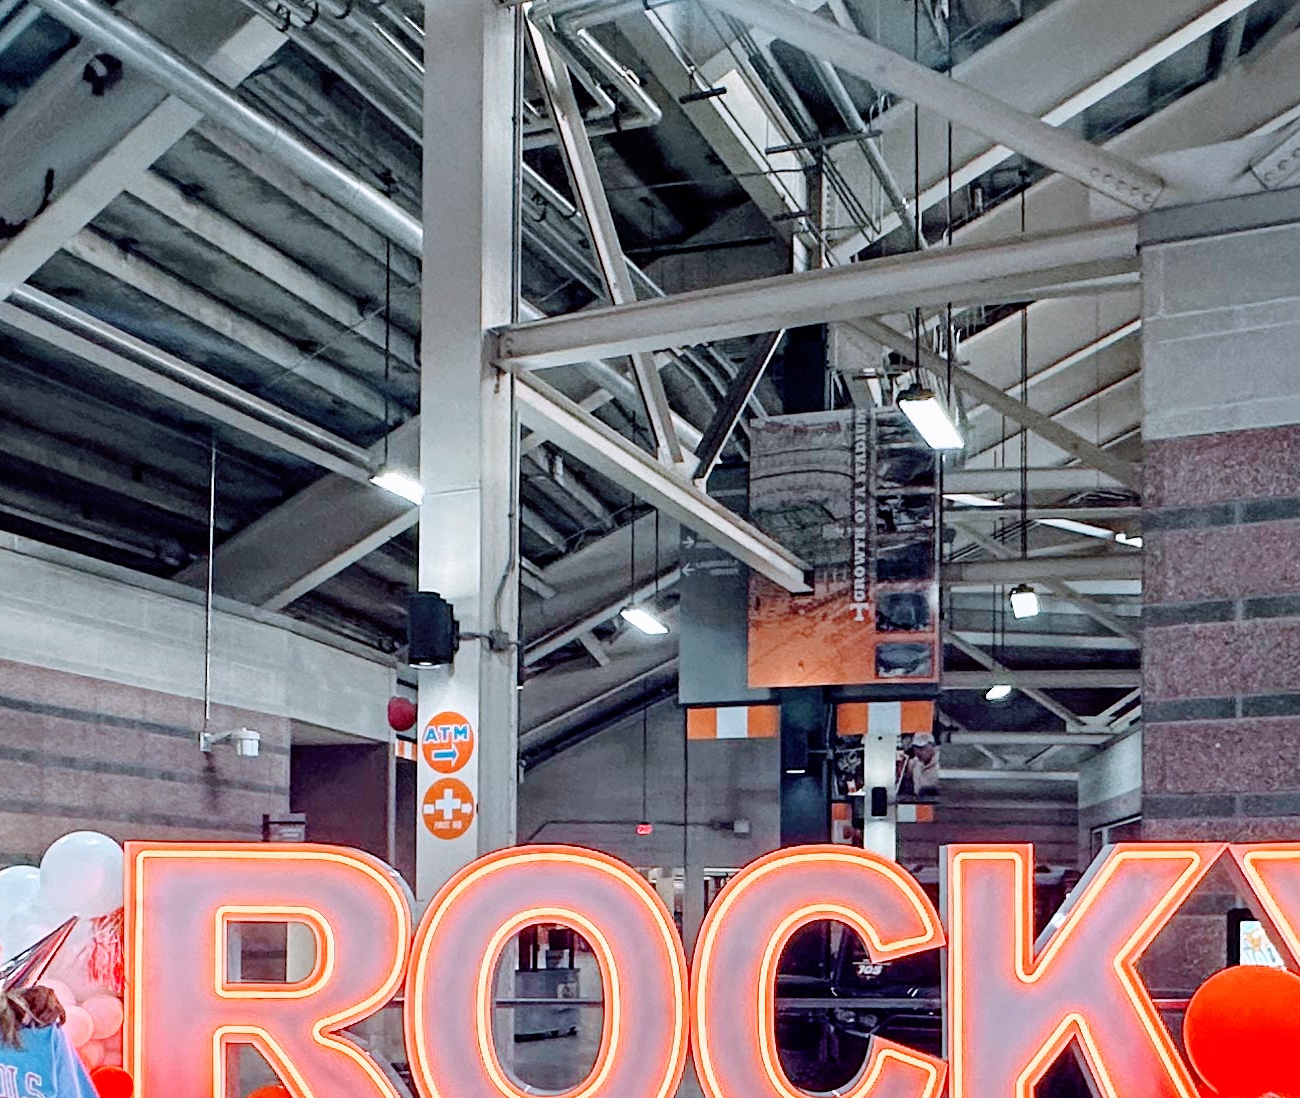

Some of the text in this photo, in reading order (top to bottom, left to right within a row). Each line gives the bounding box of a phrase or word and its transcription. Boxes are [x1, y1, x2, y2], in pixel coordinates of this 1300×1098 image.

[854, 409, 867, 484] STADIUM
[854, 503, 866, 523] OF
[854, 528, 866, 601] GROWTH
[424, 725, 469, 742] ATM
